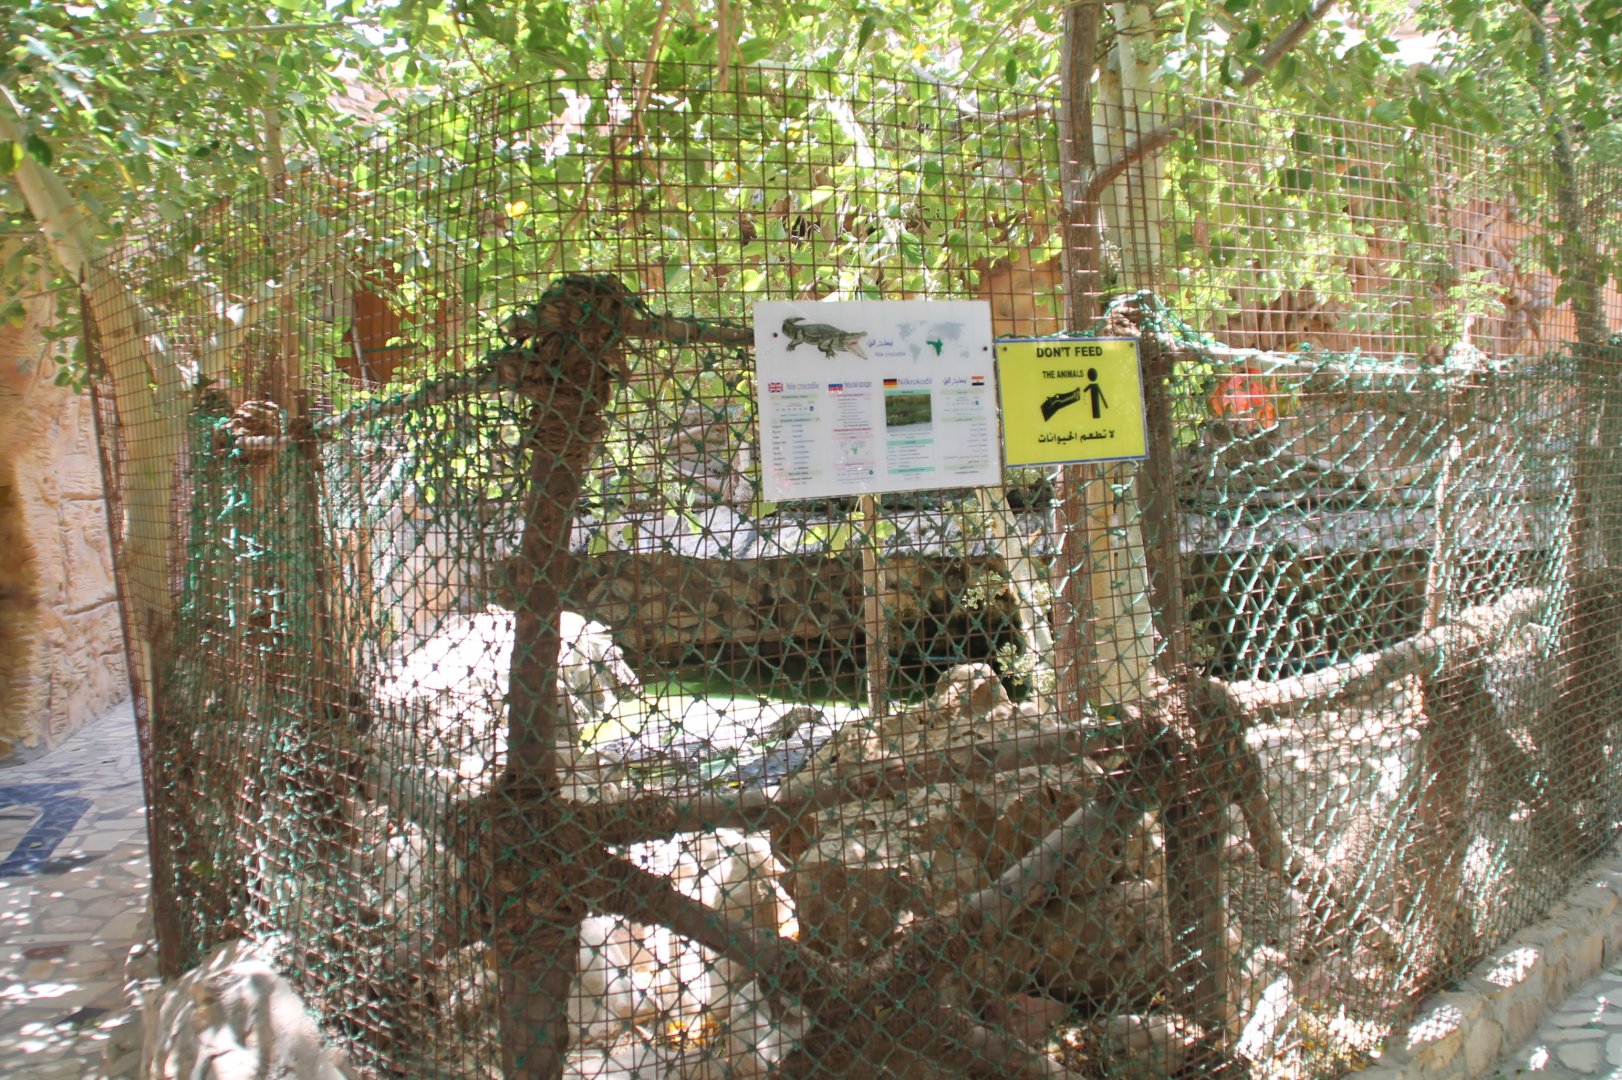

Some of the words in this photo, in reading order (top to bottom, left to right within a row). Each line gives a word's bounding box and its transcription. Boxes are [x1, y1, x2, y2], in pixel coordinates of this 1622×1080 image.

[1036, 346, 1071, 358] DON'T
[1074, 346, 1103, 357] FEED
[1042, 370, 1056, 379] THE
[1057, 369, 1084, 378] ANIMALS
[1038, 431, 1078, 445] الحيوانات
[1080, 429, 1107, 443] تطعم
[1108, 429, 1115, 439] لا
